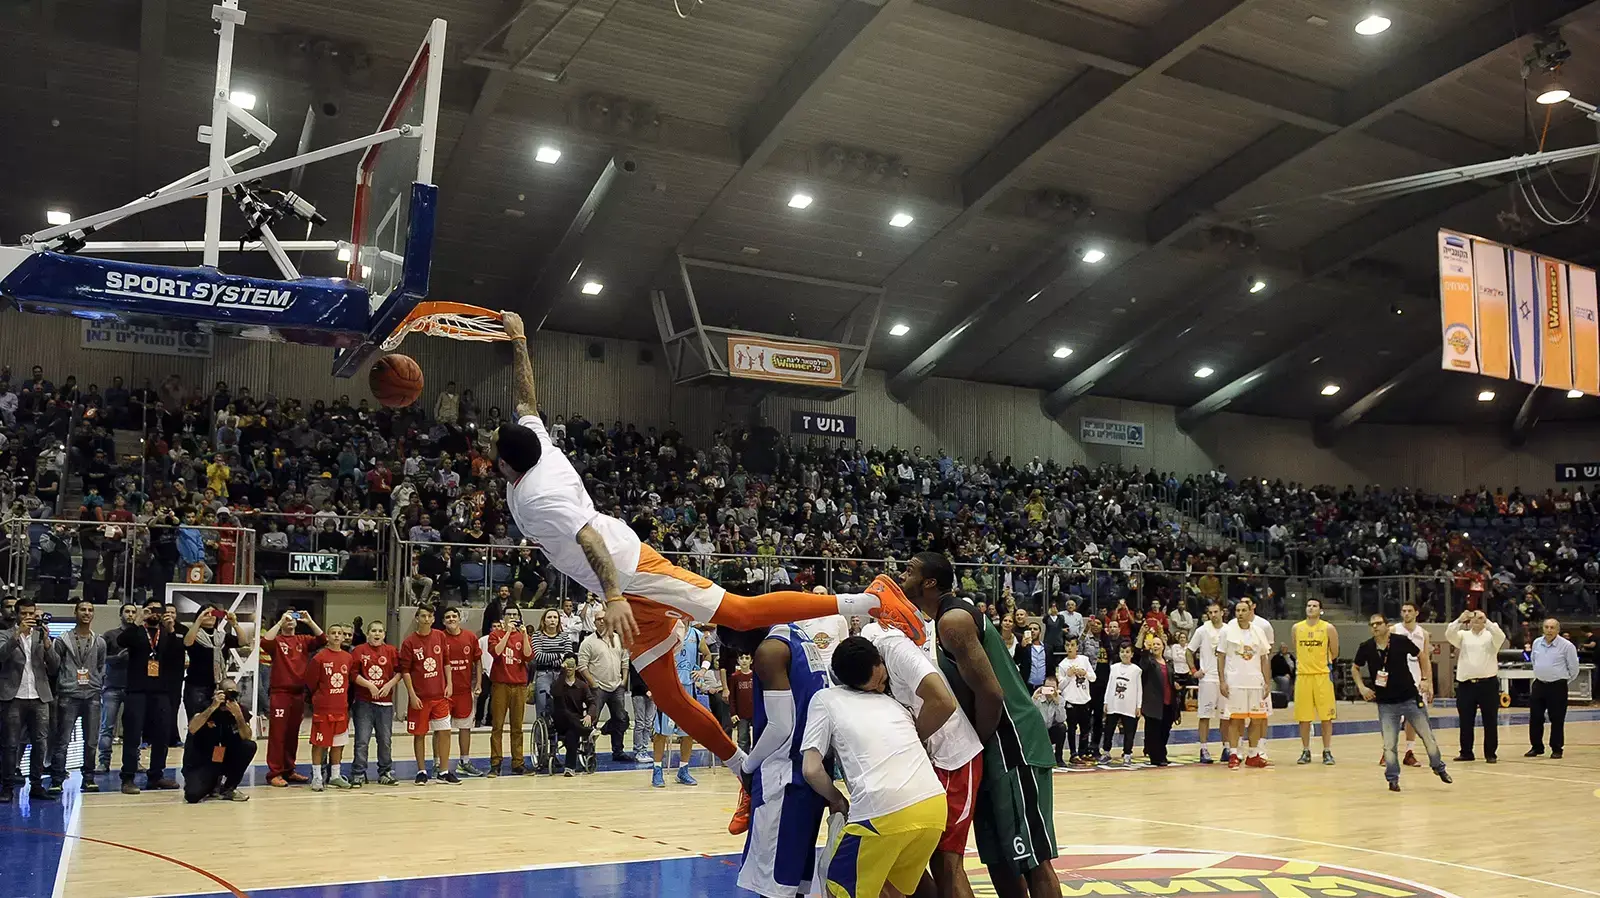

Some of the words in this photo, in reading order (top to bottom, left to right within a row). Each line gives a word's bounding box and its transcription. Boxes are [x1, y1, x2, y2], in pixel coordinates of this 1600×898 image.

[1548, 265, 1561, 330] Winner
[86, 328, 111, 343] כאן
[776, 356, 812, 370] Winner
[817, 417, 845, 433] גוש
[1565, 467, 1577, 478] ח
[294, 555, 325, 571] יציאה
[190, 567, 201, 581] 6
[274, 708, 285, 718] 32
[1013, 836, 1026, 855] 6
